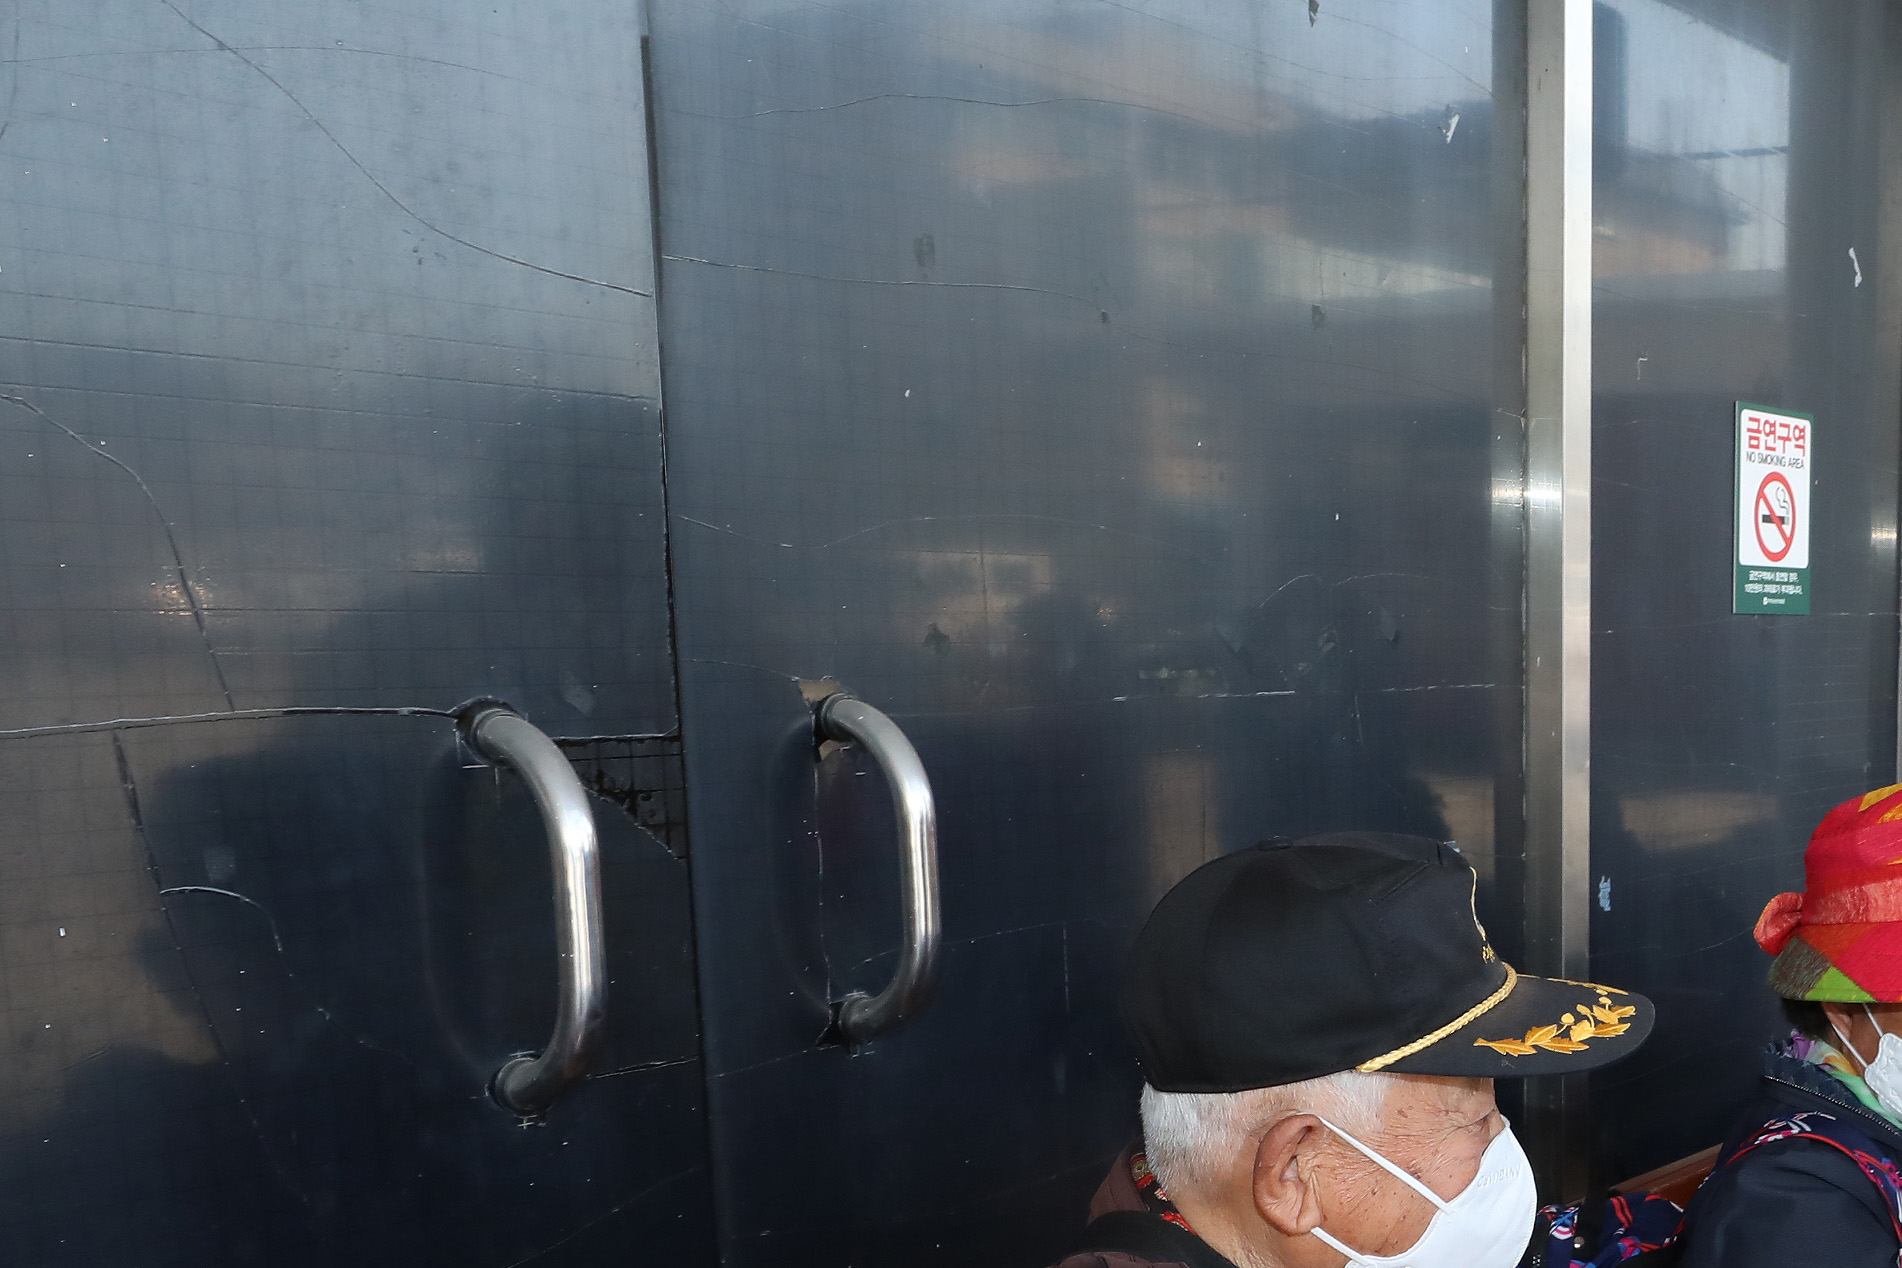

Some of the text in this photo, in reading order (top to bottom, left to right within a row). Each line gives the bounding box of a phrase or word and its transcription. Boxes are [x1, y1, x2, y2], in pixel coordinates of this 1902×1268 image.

[1746, 416, 1806, 457] 금연구역
[1746, 451, 1805, 470] NO SMOKING AREA
